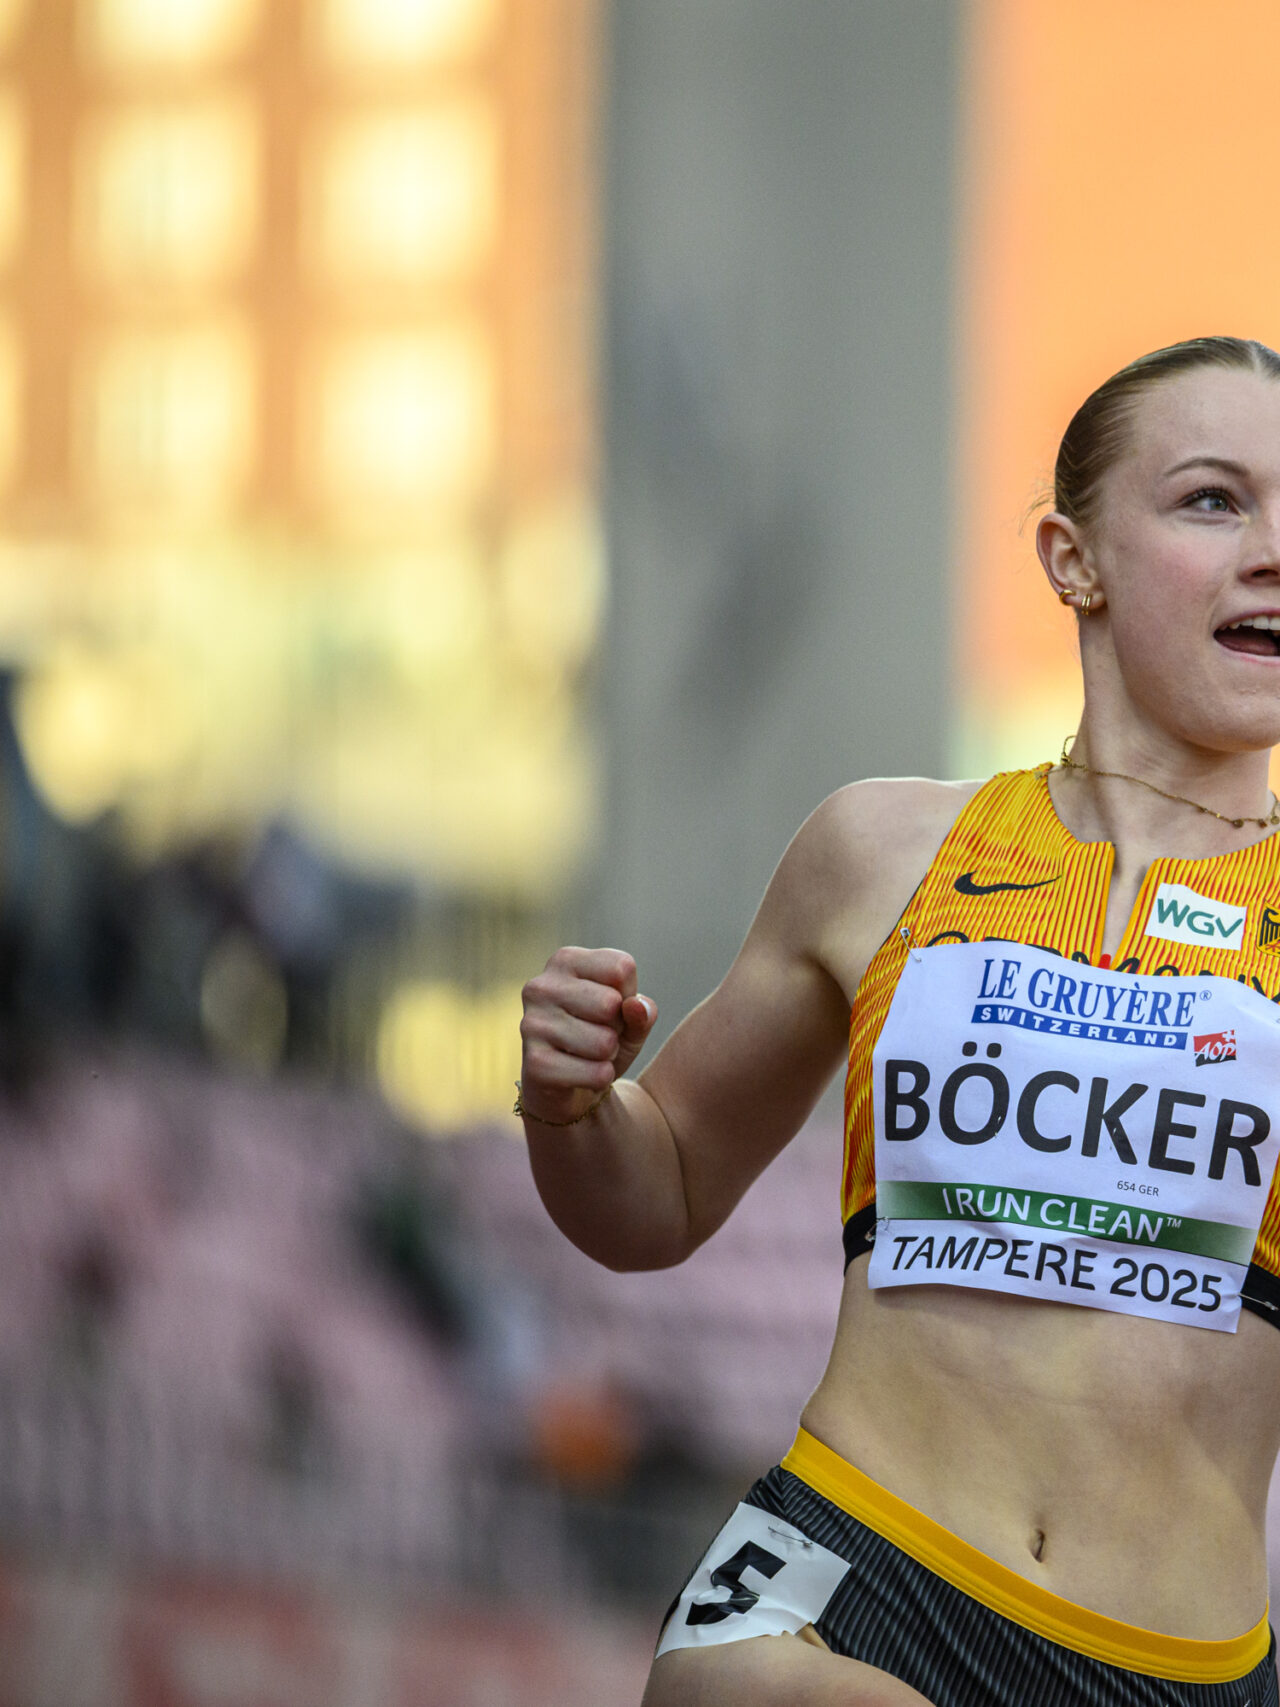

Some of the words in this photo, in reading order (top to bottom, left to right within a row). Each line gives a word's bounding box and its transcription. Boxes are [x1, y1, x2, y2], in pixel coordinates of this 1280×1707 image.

[1157, 898, 1244, 938] WGV
[977, 959, 1022, 1000] LE
[980, 1006, 1178, 1047] SWITZERLAND
[1194, 1040, 1237, 1062] AOP
[884, 1040, 1272, 1188] BÖCKER
[1116, 1180, 1137, 1194] 654
[1138, 1183, 1160, 1197] GER
[892, 1235, 1098, 1291] TAMPERE
[1109, 1257, 1223, 1313] 2025
[685, 1540, 787, 1626] 5
